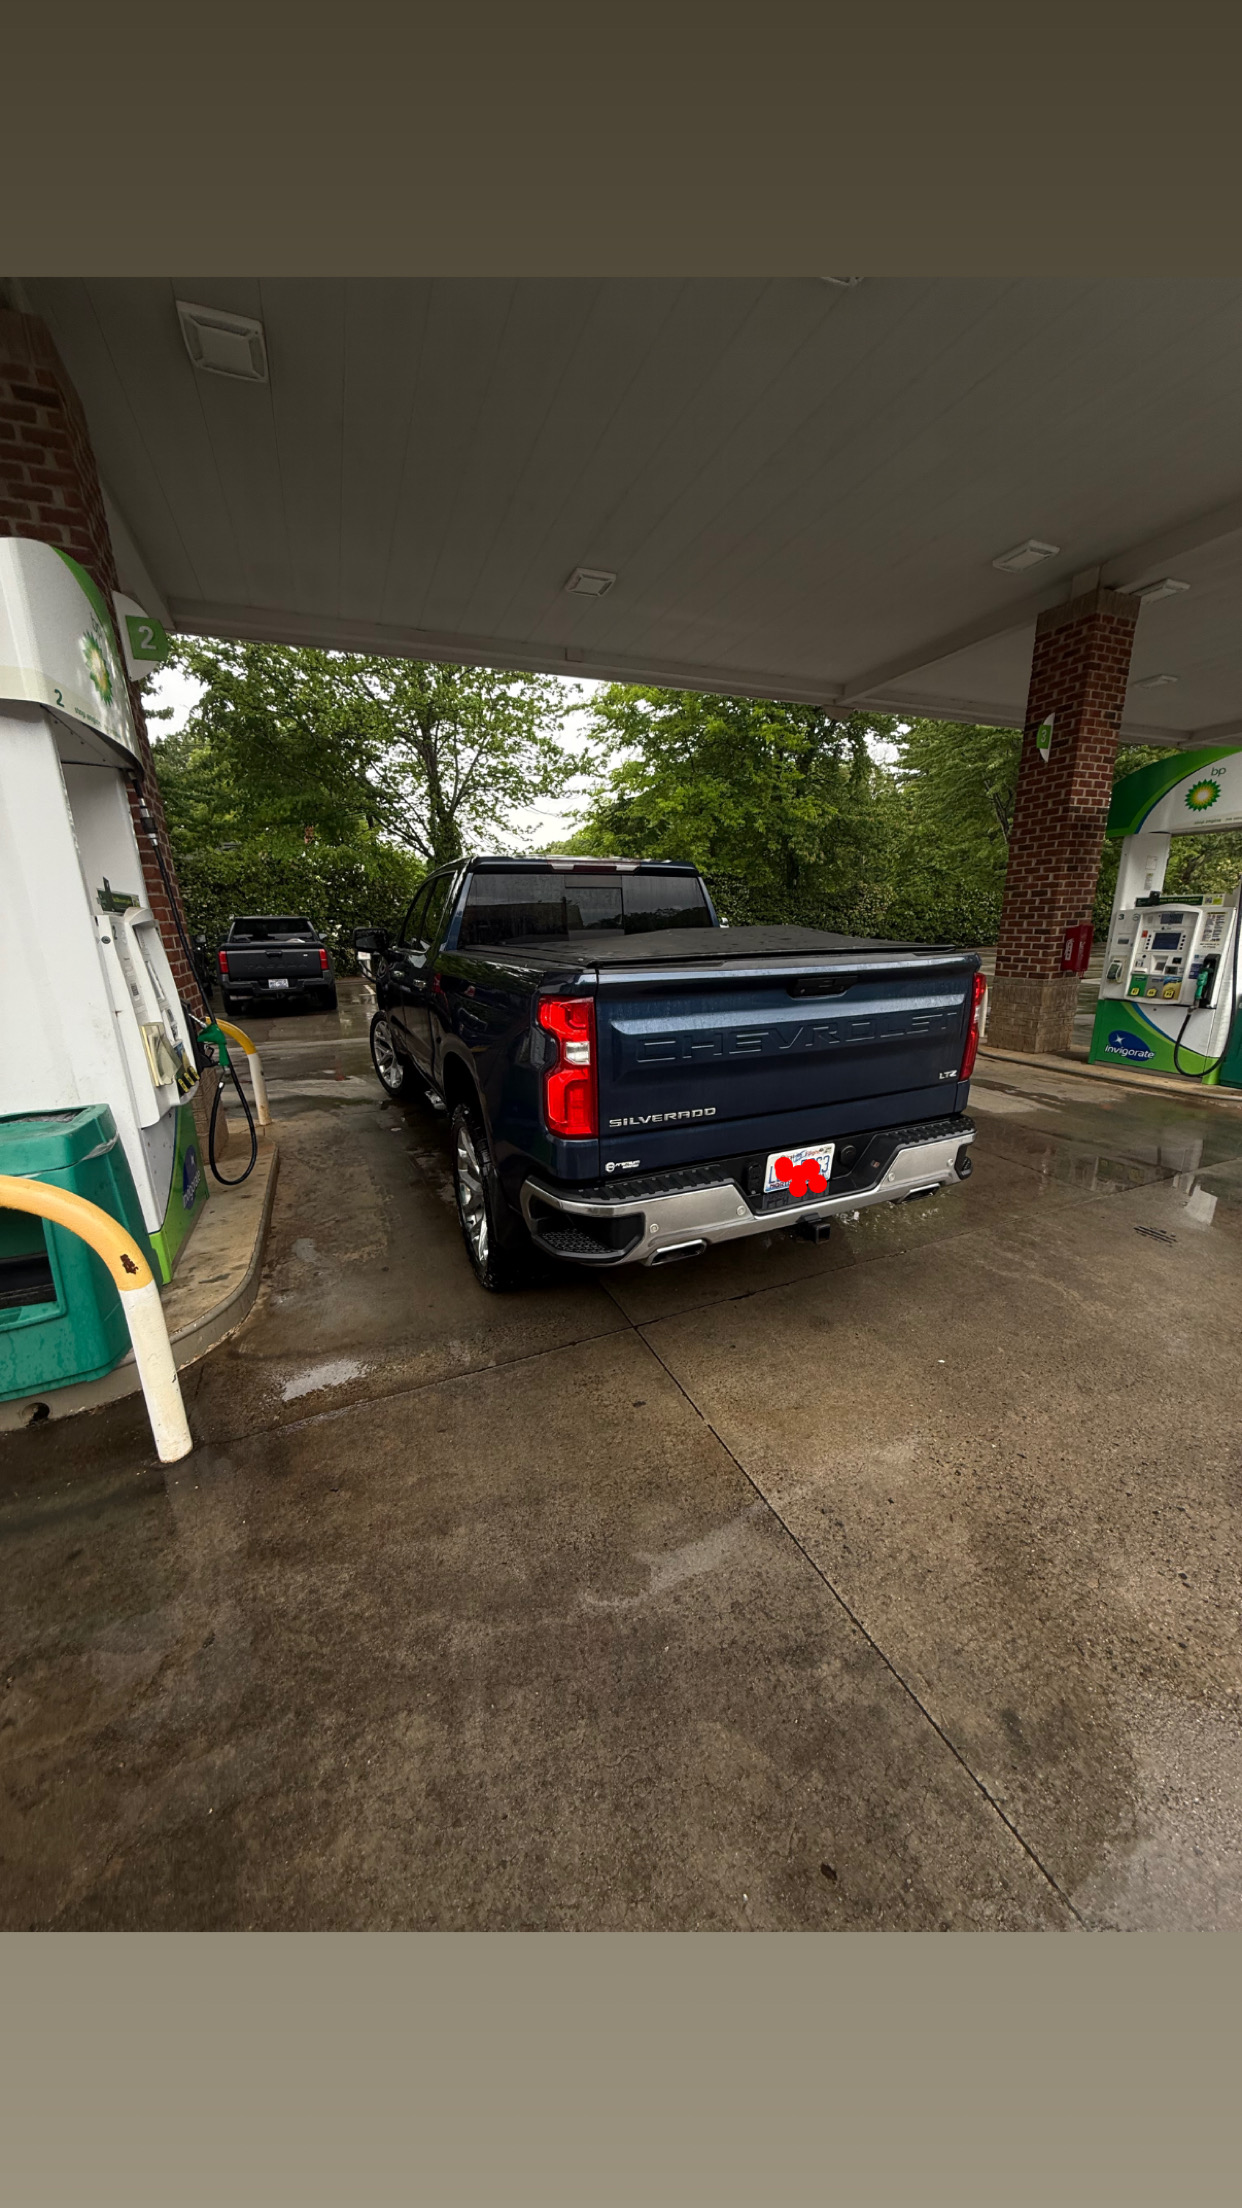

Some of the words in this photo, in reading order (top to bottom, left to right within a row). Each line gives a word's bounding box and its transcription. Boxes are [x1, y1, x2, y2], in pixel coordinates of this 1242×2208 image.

[138, 625, 156, 649] 2
[54, 689, 65, 707] 2
[1041, 729, 1048, 743] 3
[1210, 767, 1227, 777] bp
[636, 1010, 958, 1063] CHEVROLET
[1104, 1045, 1156, 1059] Invigorate
[938, 1069, 958, 1080] LTZ
[608, 1106, 717, 1128] SILVERADO
